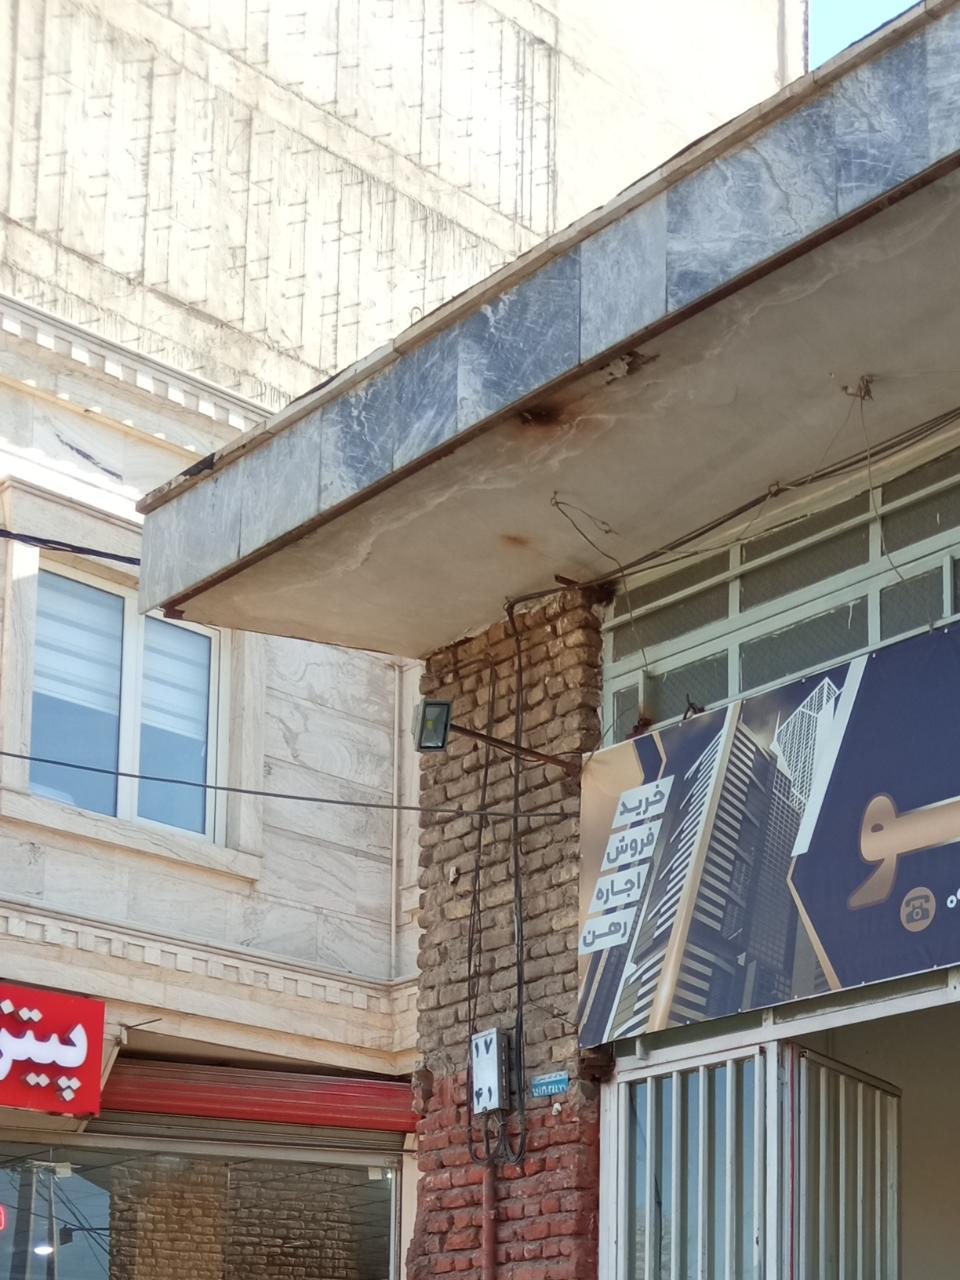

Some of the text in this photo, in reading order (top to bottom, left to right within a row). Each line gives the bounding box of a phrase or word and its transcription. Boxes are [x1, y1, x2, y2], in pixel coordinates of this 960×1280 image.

[619, 783, 666, 817] خرید
[606, 827, 655, 864] فروش
[595, 871, 642, 906] اجاره
[582, 920, 629, 948] رهن
